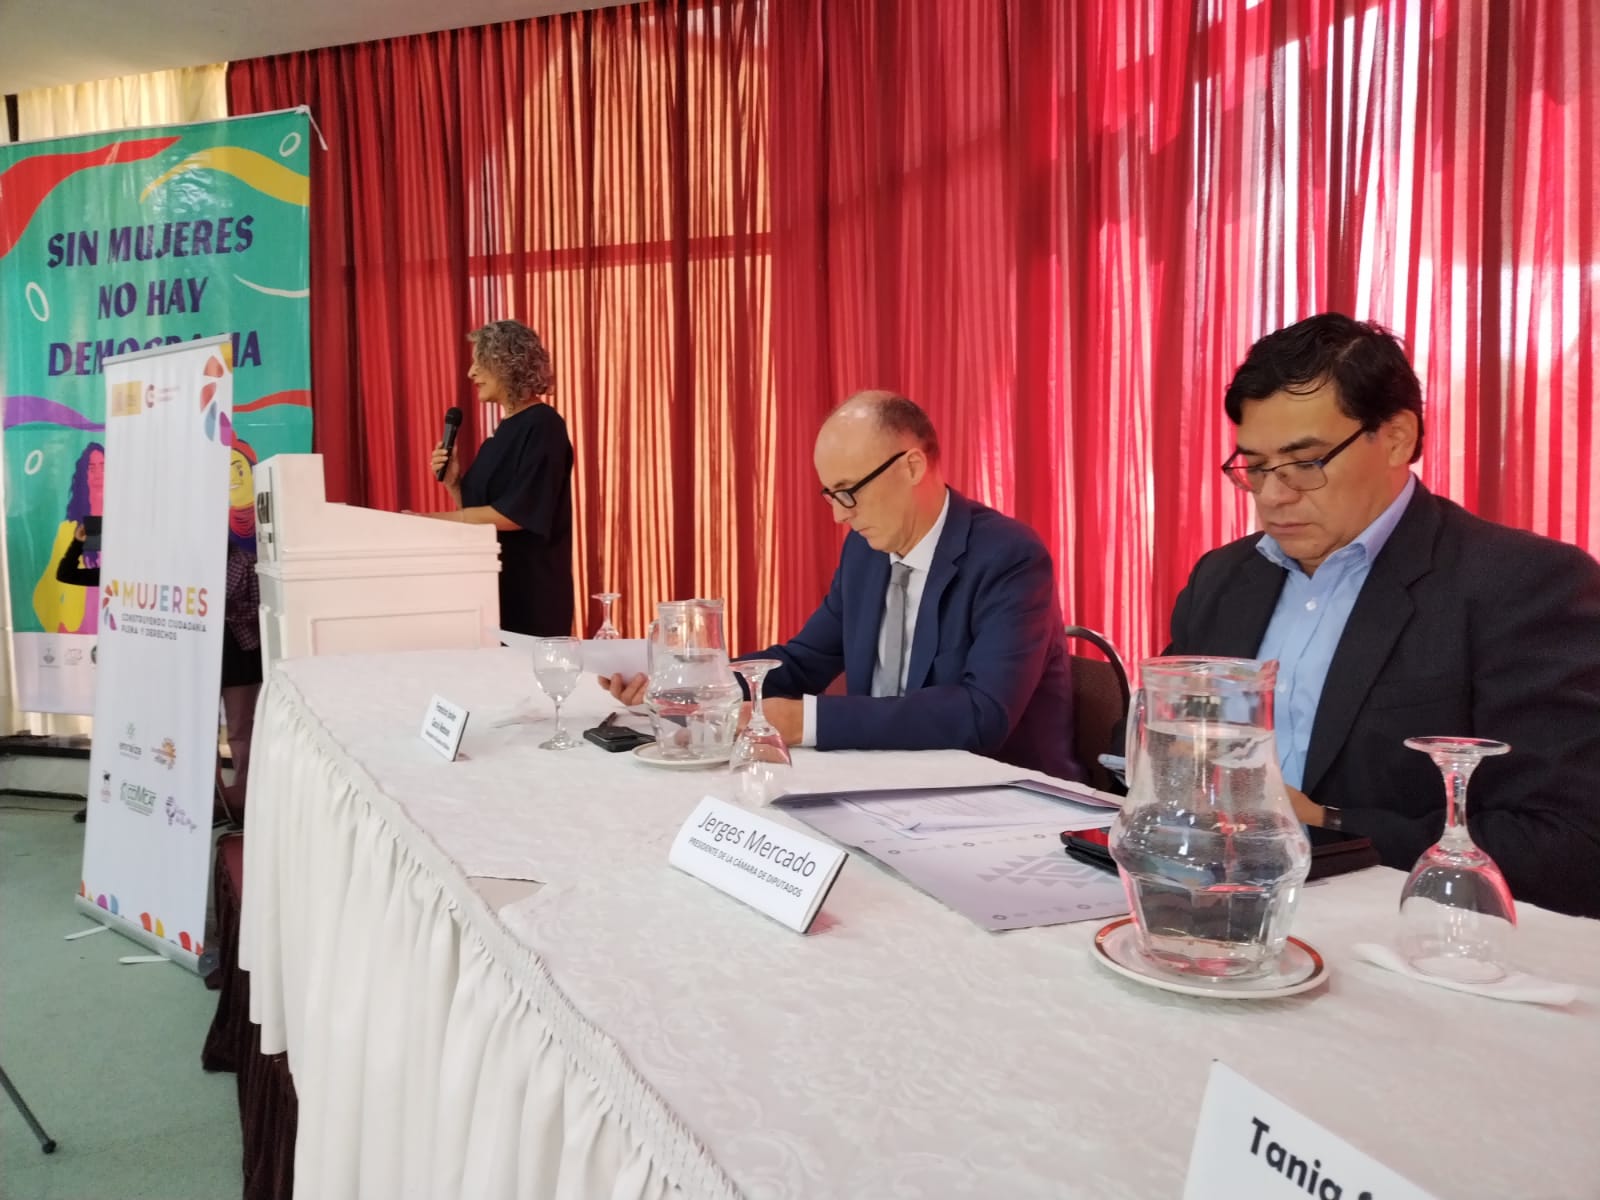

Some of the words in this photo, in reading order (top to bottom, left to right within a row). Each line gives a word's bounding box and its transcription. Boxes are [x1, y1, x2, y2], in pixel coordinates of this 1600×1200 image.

[48, 229, 99, 268] SIN
[107, 215, 254, 264] MUJERES
[98, 281, 137, 320] NO
[146, 276, 208, 317] HAY
[48, 330, 262, 376] DEMIA
[122, 581, 208, 617] MUJERES
[688, 836, 719, 856] PRESIDENTE
[717, 849, 727, 860] DE
[725, 853, 734, 864] LA
[757, 870, 767, 881] DE
[766, 873, 803, 898] DIPUTADOS
[698, 812, 745, 844] Jerges
[743, 829, 817, 878] Mercado
[1250, 1116, 1343, 1200] Tania
